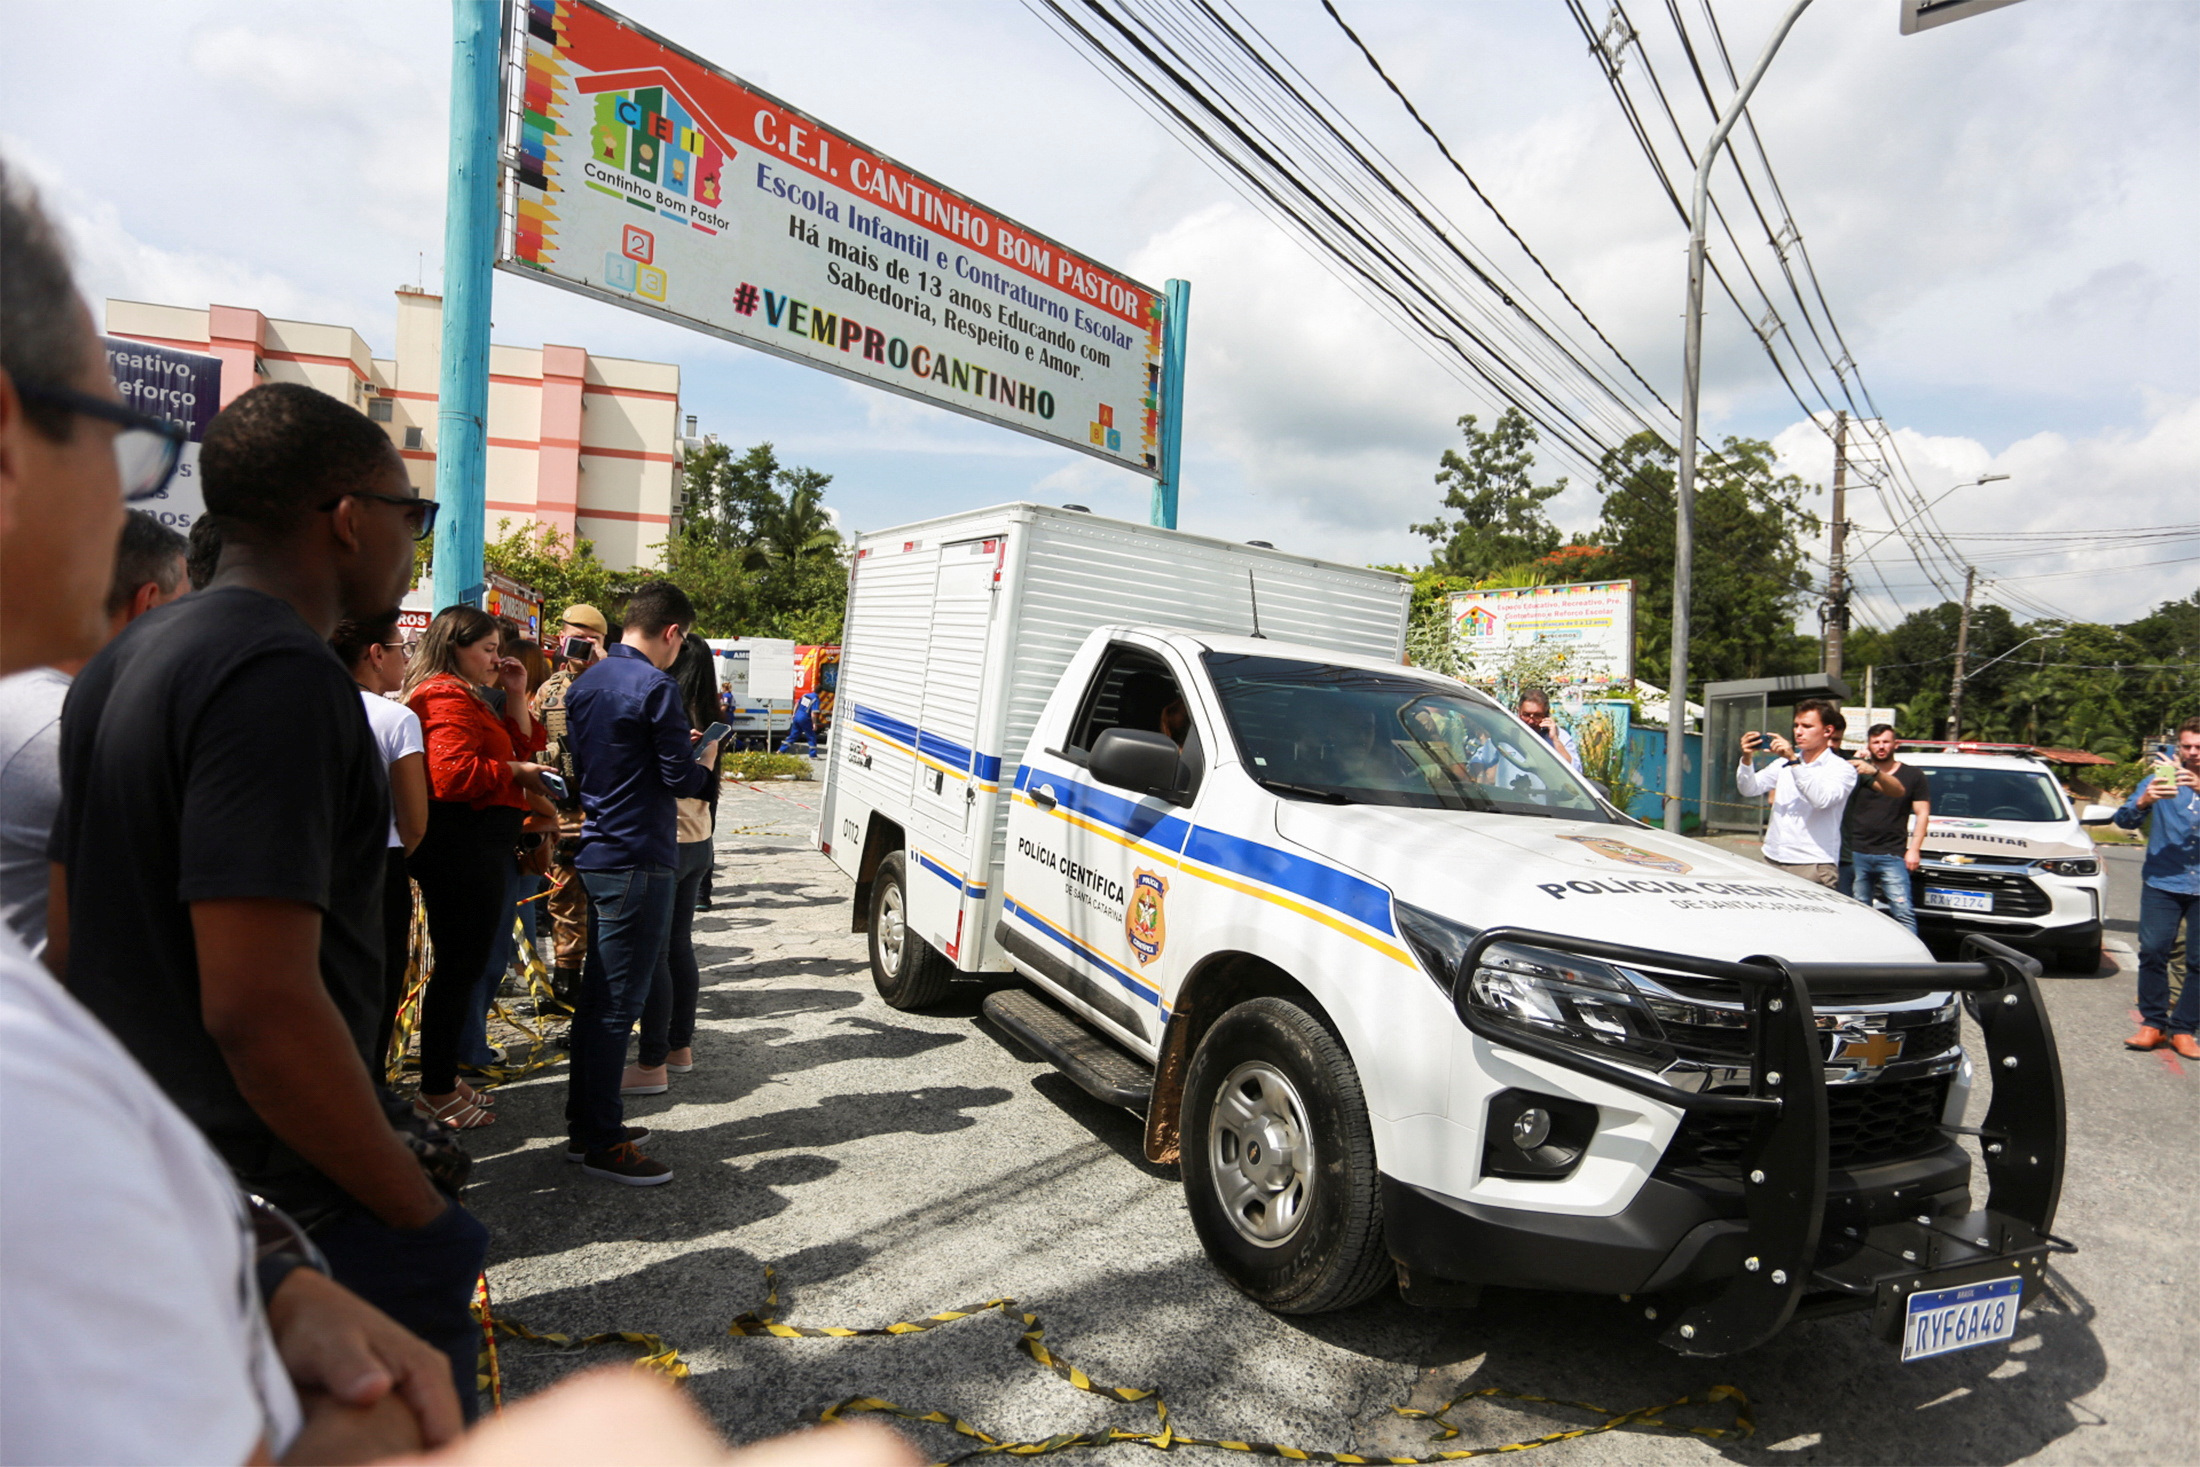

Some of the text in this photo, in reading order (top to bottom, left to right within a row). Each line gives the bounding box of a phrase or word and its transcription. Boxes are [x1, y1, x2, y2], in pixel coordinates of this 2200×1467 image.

[583, 162, 730, 232] Cantinho Bom Pastor
[753, 109, 1140, 320] C.E.I. CANTINHO BOM PASTOR
[630, 234, 646, 256] 2
[756, 162, 1134, 351] Escola Infantil e Contraturno Escolar
[615, 263, 659, 292] 1 3
[788, 213, 1111, 369] Há mais de 13 anos Educando com
[826, 260, 1084, 382] Sabedoria, Respeito e Amor.
[732, 281, 1056, 421] #VEMPROCANTINHO
[842, 818, 860, 845] 0112
[1961, 832, 2028, 849] MILITAR
[1017, 836, 1125, 906] POLÍCIA CIENTÍFICA
[1537, 877, 1702, 900] POLÍCIA
[1064, 883, 1123, 924] DE SANTA CATARINA
[1670, 899, 1702, 910] DE
[1703, 899, 1764, 911] SANTA
[1914, 1300, 2006, 1352] RYF6A48
